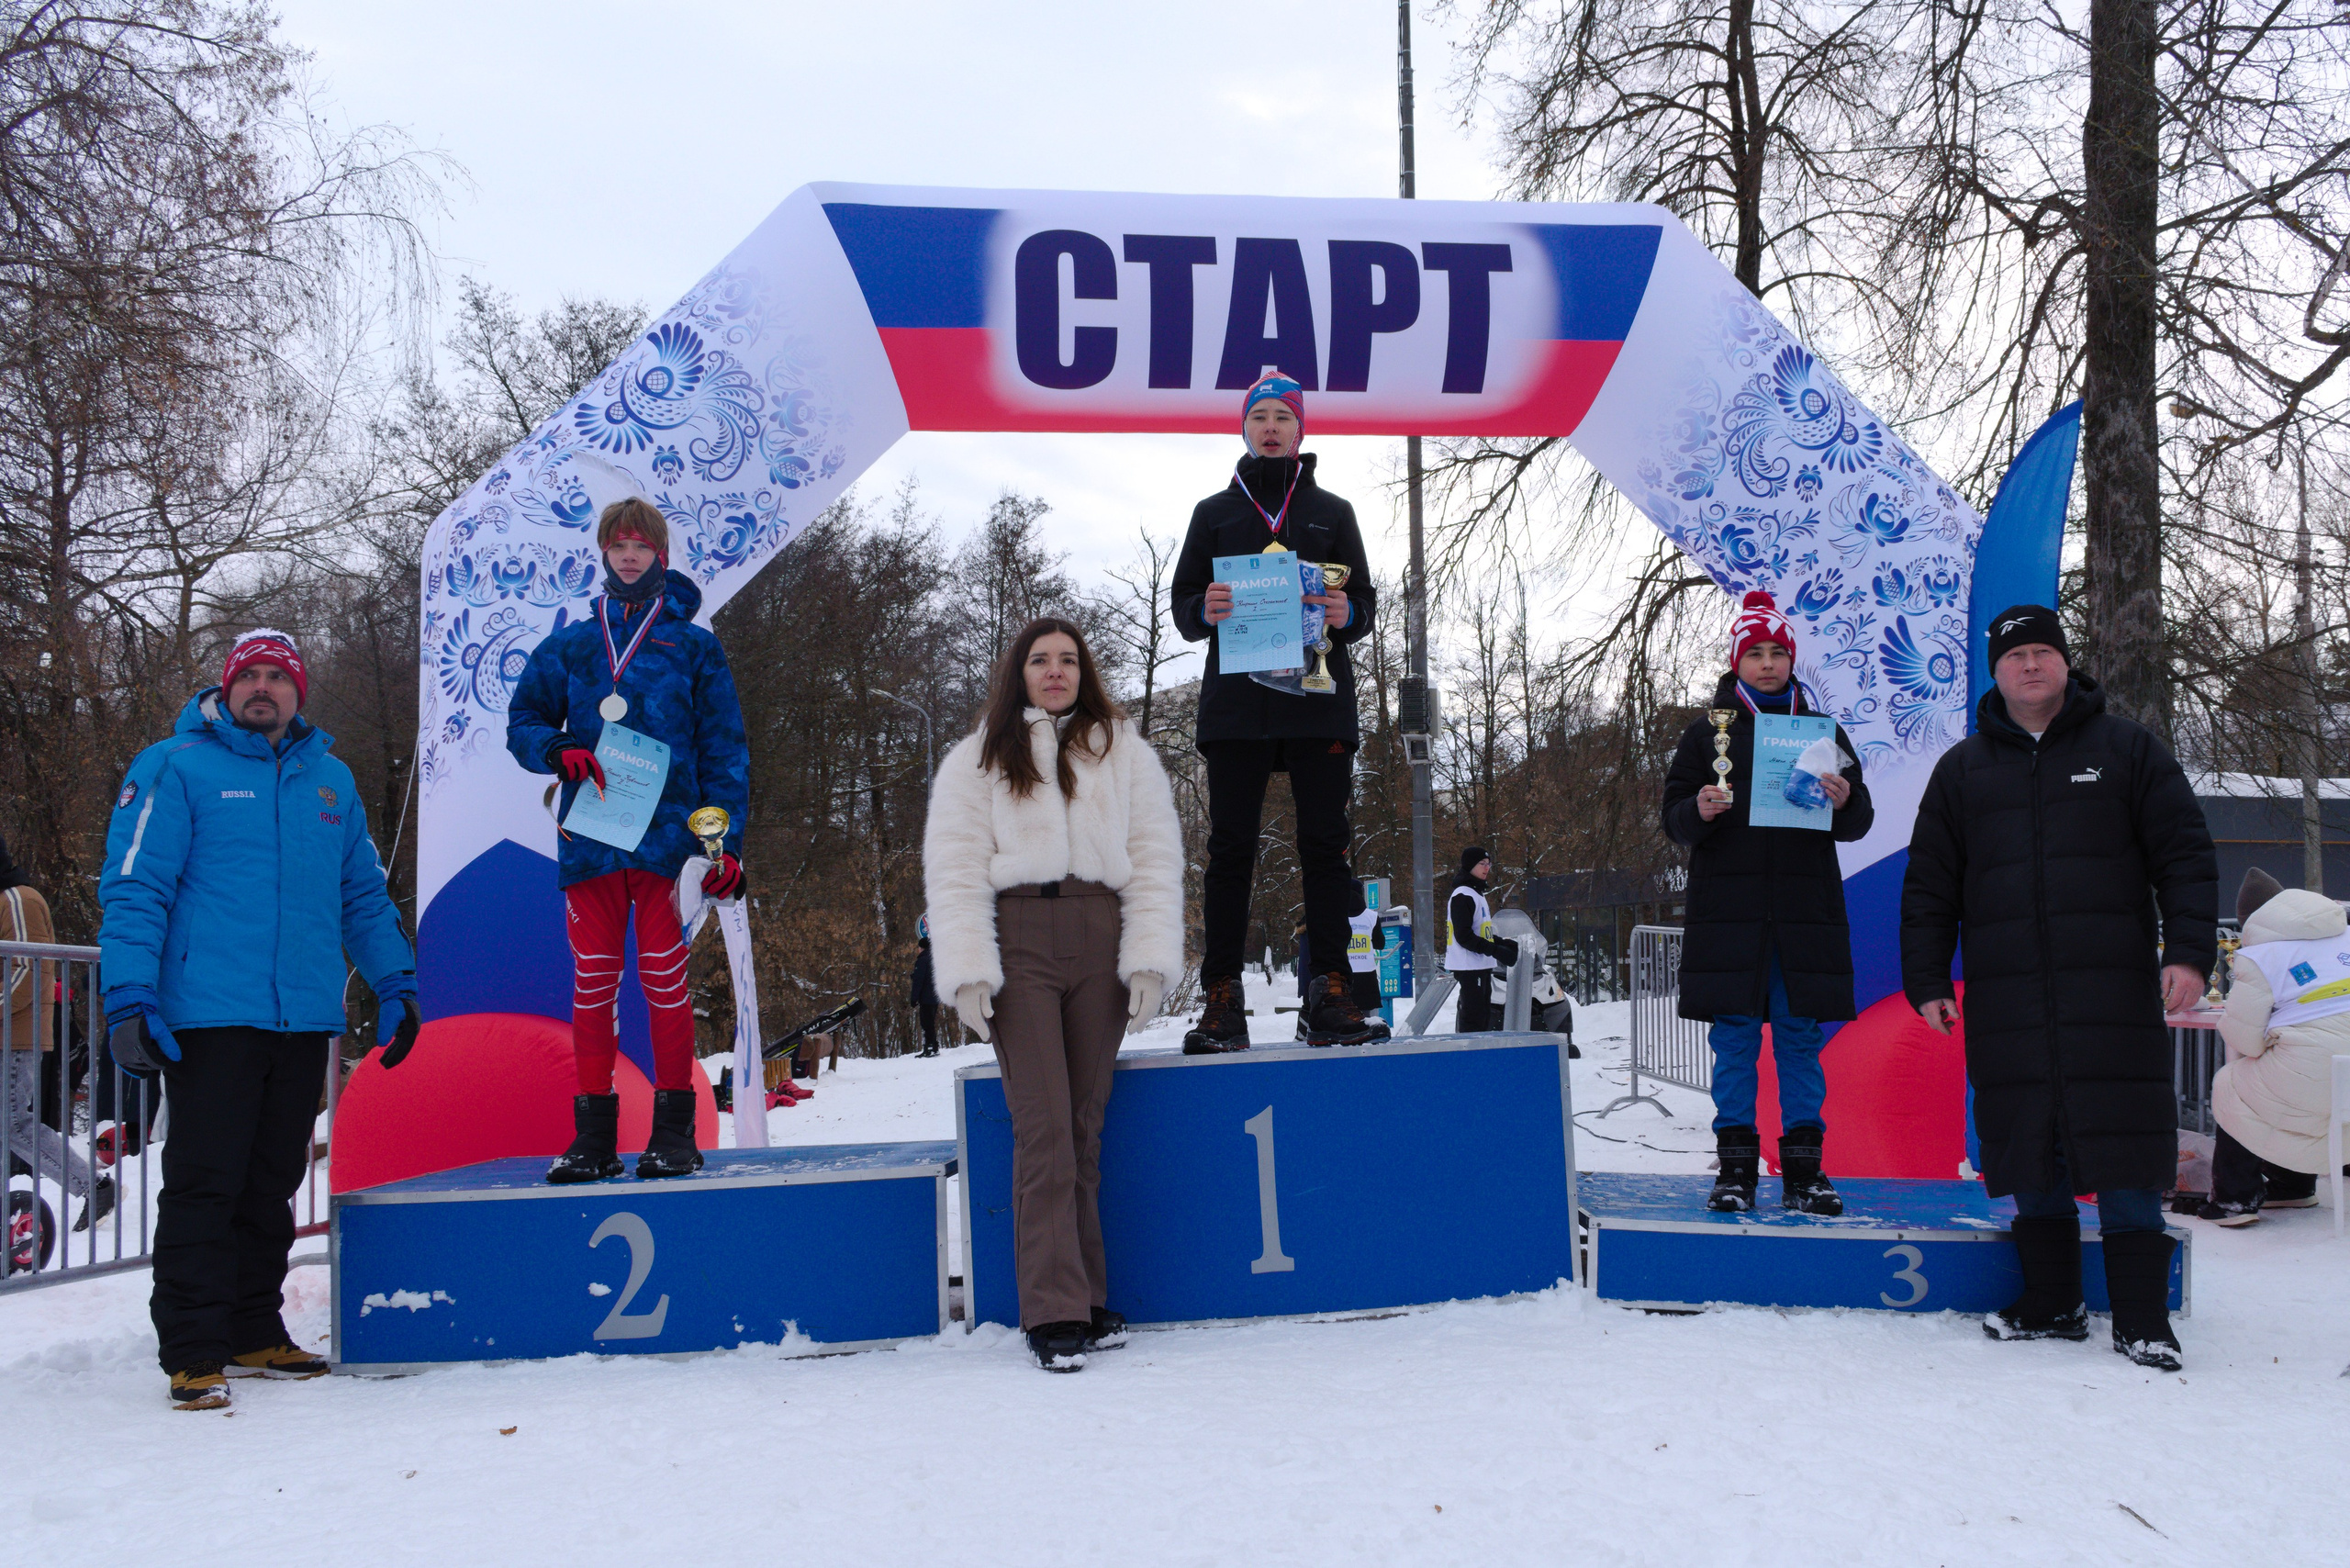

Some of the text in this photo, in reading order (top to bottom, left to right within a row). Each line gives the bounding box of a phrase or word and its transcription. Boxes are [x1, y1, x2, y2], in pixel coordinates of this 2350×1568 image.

[1014, 229, 1513, 395] СТАРТ
[227, 644, 301, 678] 2026
[1763, 737, 1817, 749] ГРАМО
[602, 745, 659, 774] ГРАМОТА
[2071, 774, 2097, 783] PUMA
[221, 790, 256, 799] RUSSIA
[319, 812, 341, 826] RUS
[1348, 937, 1367, 950] ДЬЯ
[1244, 1104, 1295, 1275] 1
[588, 1212, 670, 1340] 2
[1879, 1244, 1930, 1308] 3
